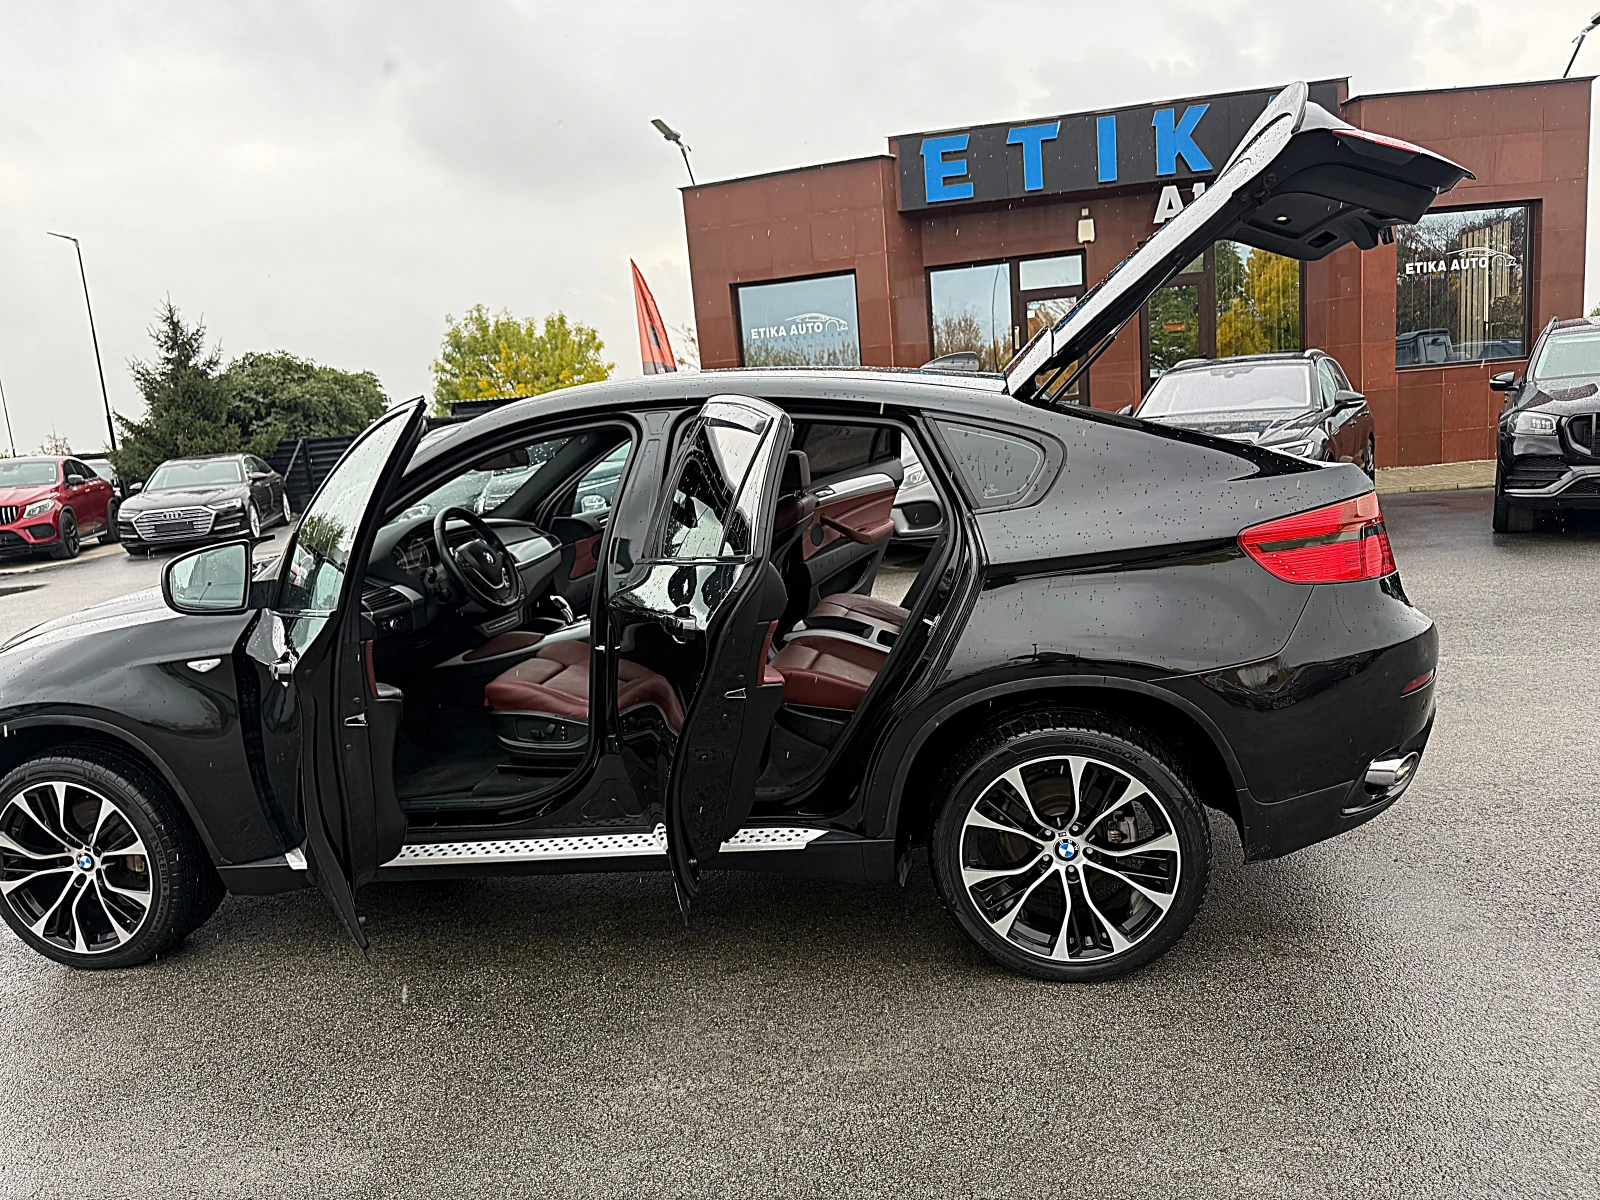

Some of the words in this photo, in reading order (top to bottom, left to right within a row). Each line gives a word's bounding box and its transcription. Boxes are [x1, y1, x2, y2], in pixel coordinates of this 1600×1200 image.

[919, 95, 1278, 203] ETIK
[1405, 260, 1447, 275] ETIKA
[1450, 256, 1488, 271] AUTO
[751, 326, 787, 339] ETIKA
[790, 322, 823, 335] AUTO
